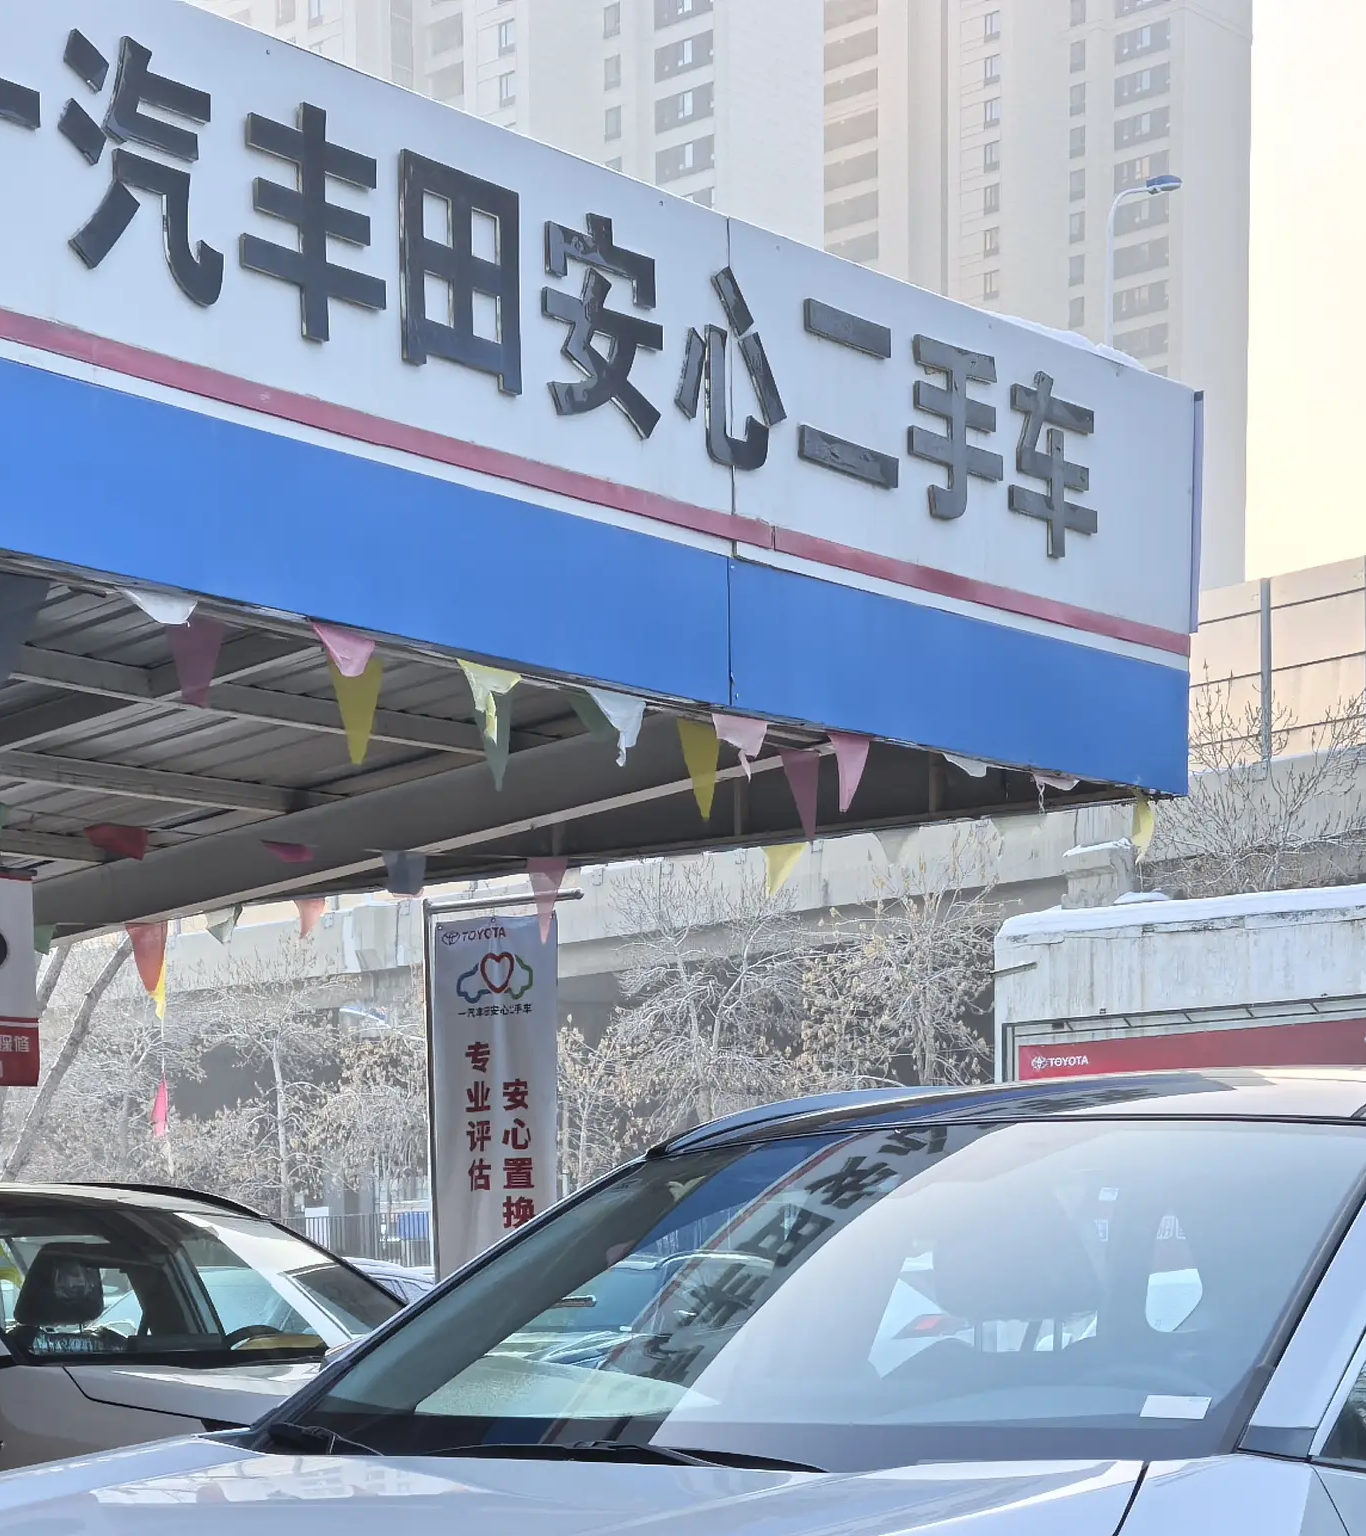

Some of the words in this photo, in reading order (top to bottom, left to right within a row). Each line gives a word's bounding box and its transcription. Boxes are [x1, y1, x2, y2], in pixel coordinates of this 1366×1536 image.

[461, 926, 506, 942] TOYOTA
[1048, 1054, 1089, 1068] TOYOTA
[465, 1041, 493, 1192] 专业评估
[502, 1078, 536, 1230] 安心置换
